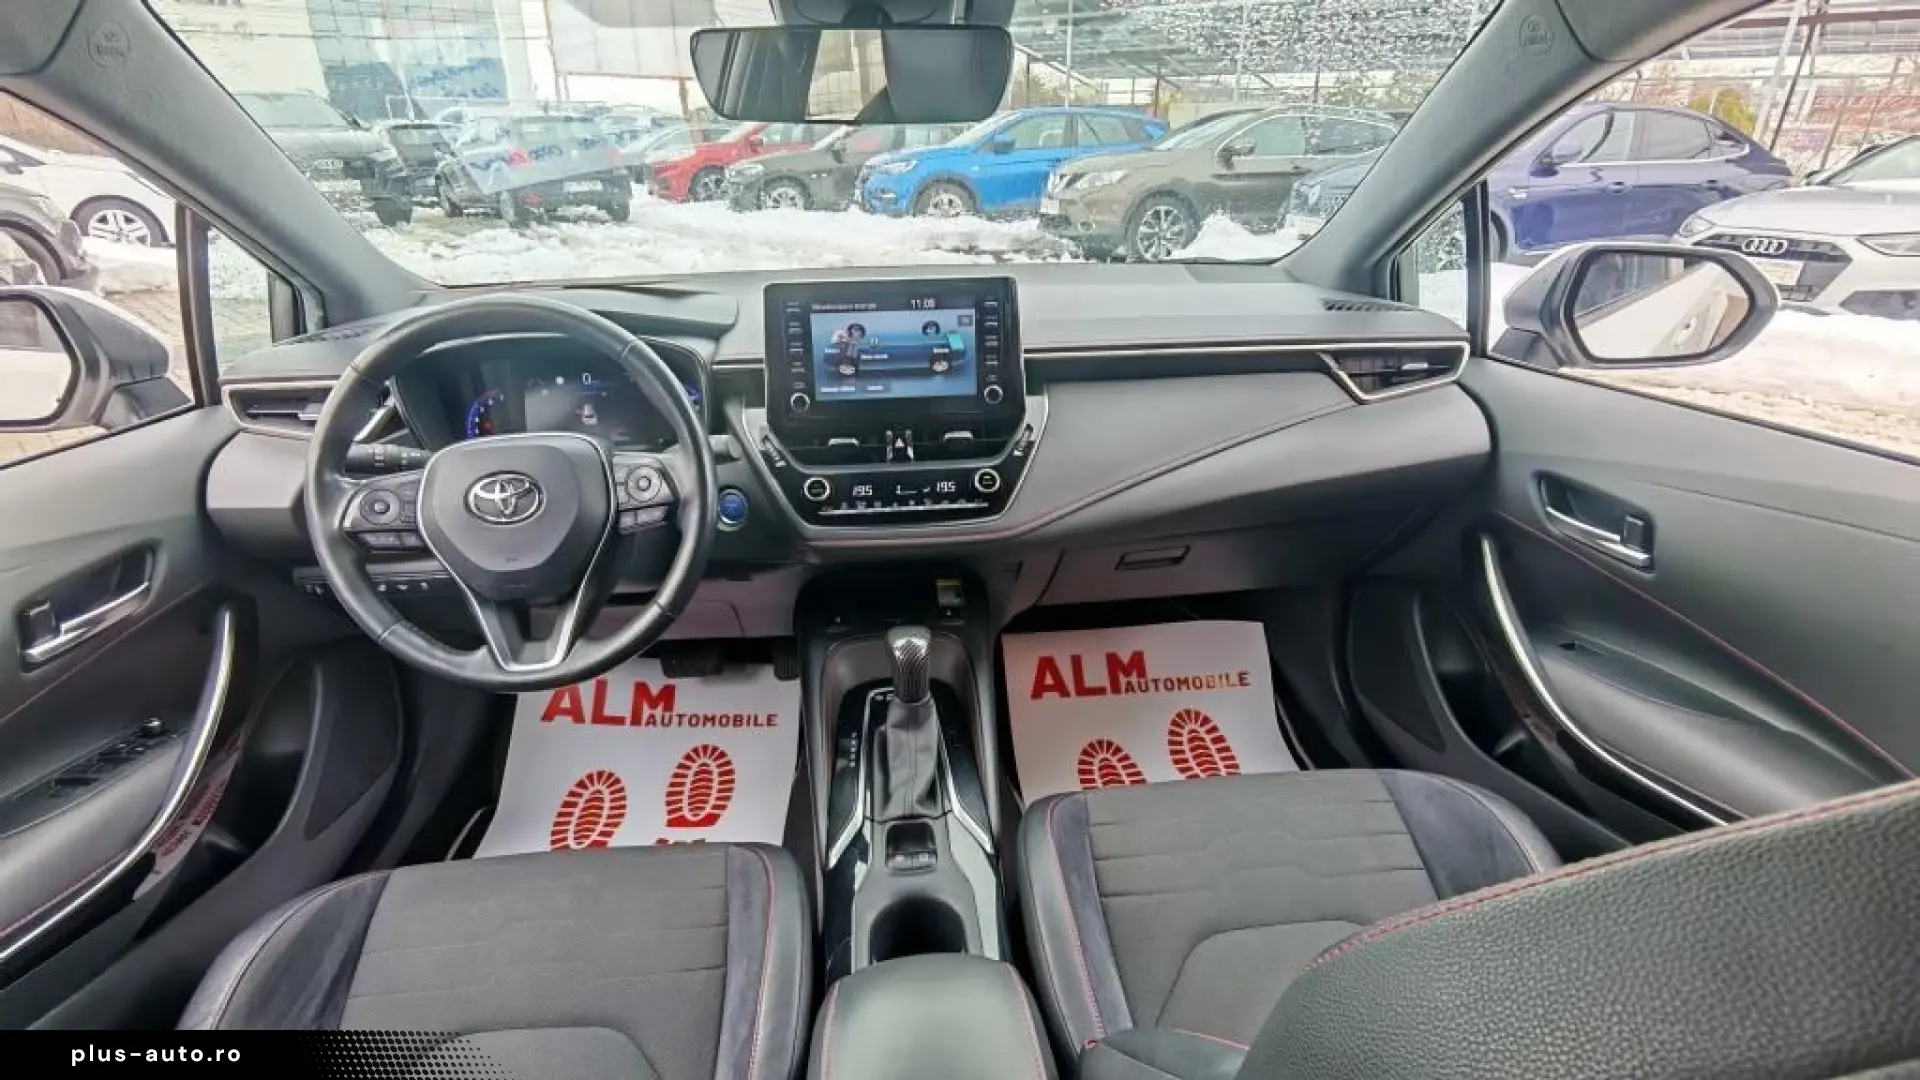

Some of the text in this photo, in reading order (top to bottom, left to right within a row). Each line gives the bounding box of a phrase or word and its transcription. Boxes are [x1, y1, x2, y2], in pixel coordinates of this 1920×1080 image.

[1031, 651, 1251, 700] ALM AUTOMOBILE
[540, 676, 778, 728] ALM AUTOMOBILE
